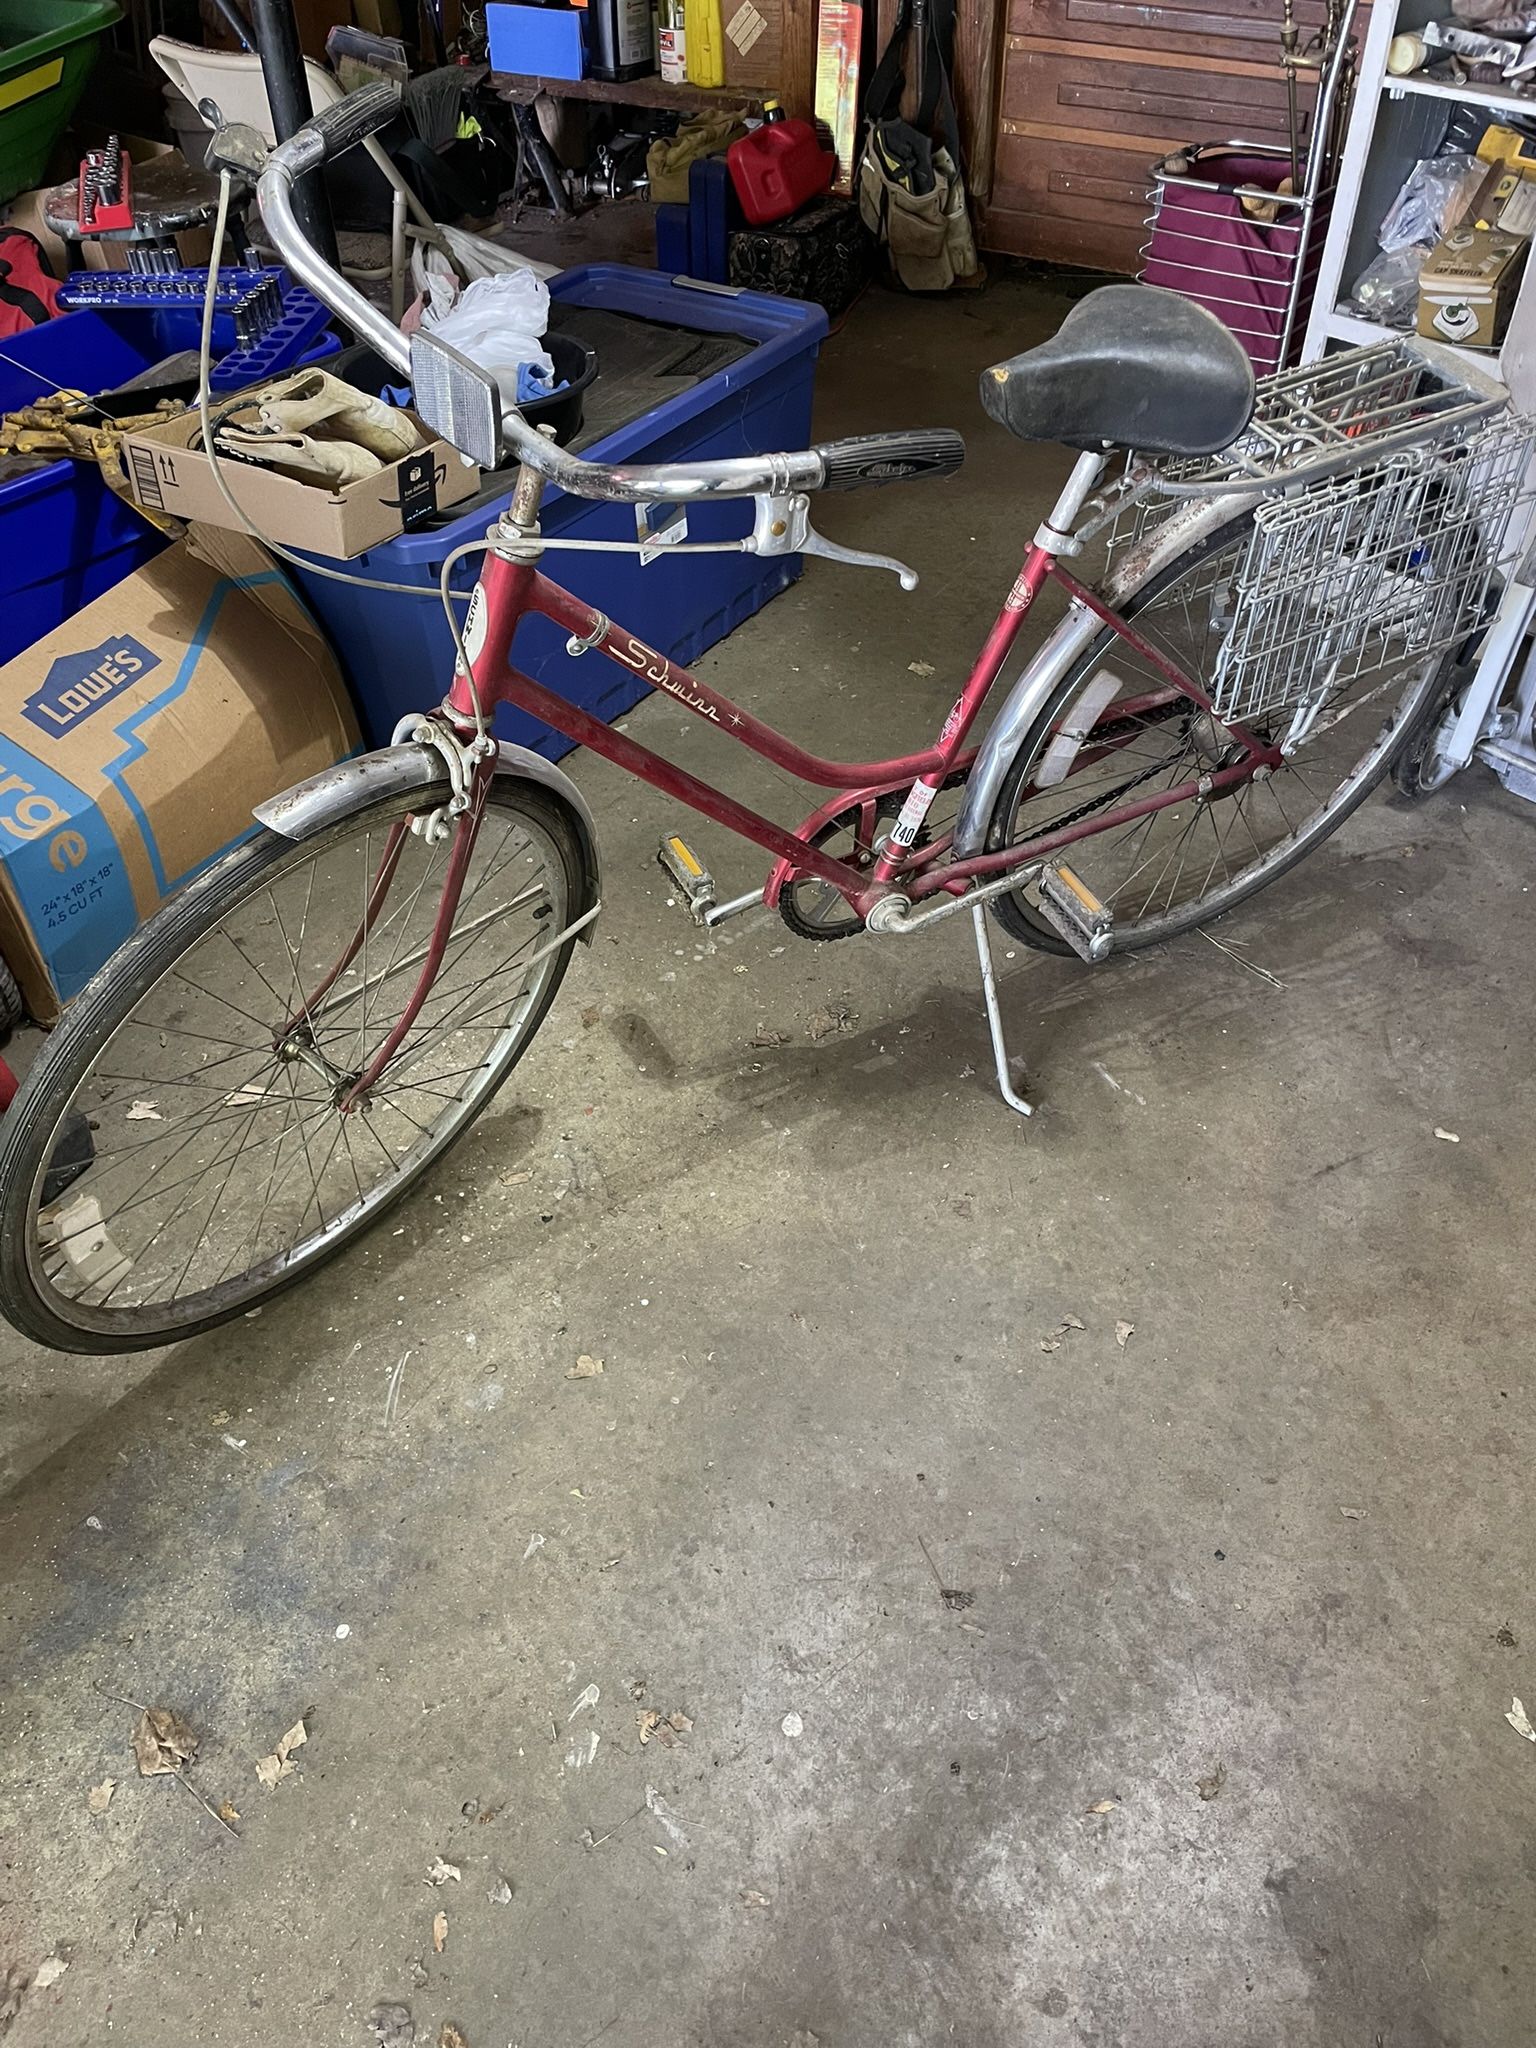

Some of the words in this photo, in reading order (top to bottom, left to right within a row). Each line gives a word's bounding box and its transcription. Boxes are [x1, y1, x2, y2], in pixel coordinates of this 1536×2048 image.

[66, 296, 102, 304] WORKPRO
[37, 649, 142, 725] LOWE'S
[608, 639, 720, 722] Schwinn
[41, 895, 61, 916] 24"
[70, 880, 87, 896] 18"
[97, 863, 114, 880] 18"
[47, 912, 67, 929] 4.5
[68, 898, 87, 916] CU
[89, 886, 104, 902] FT
